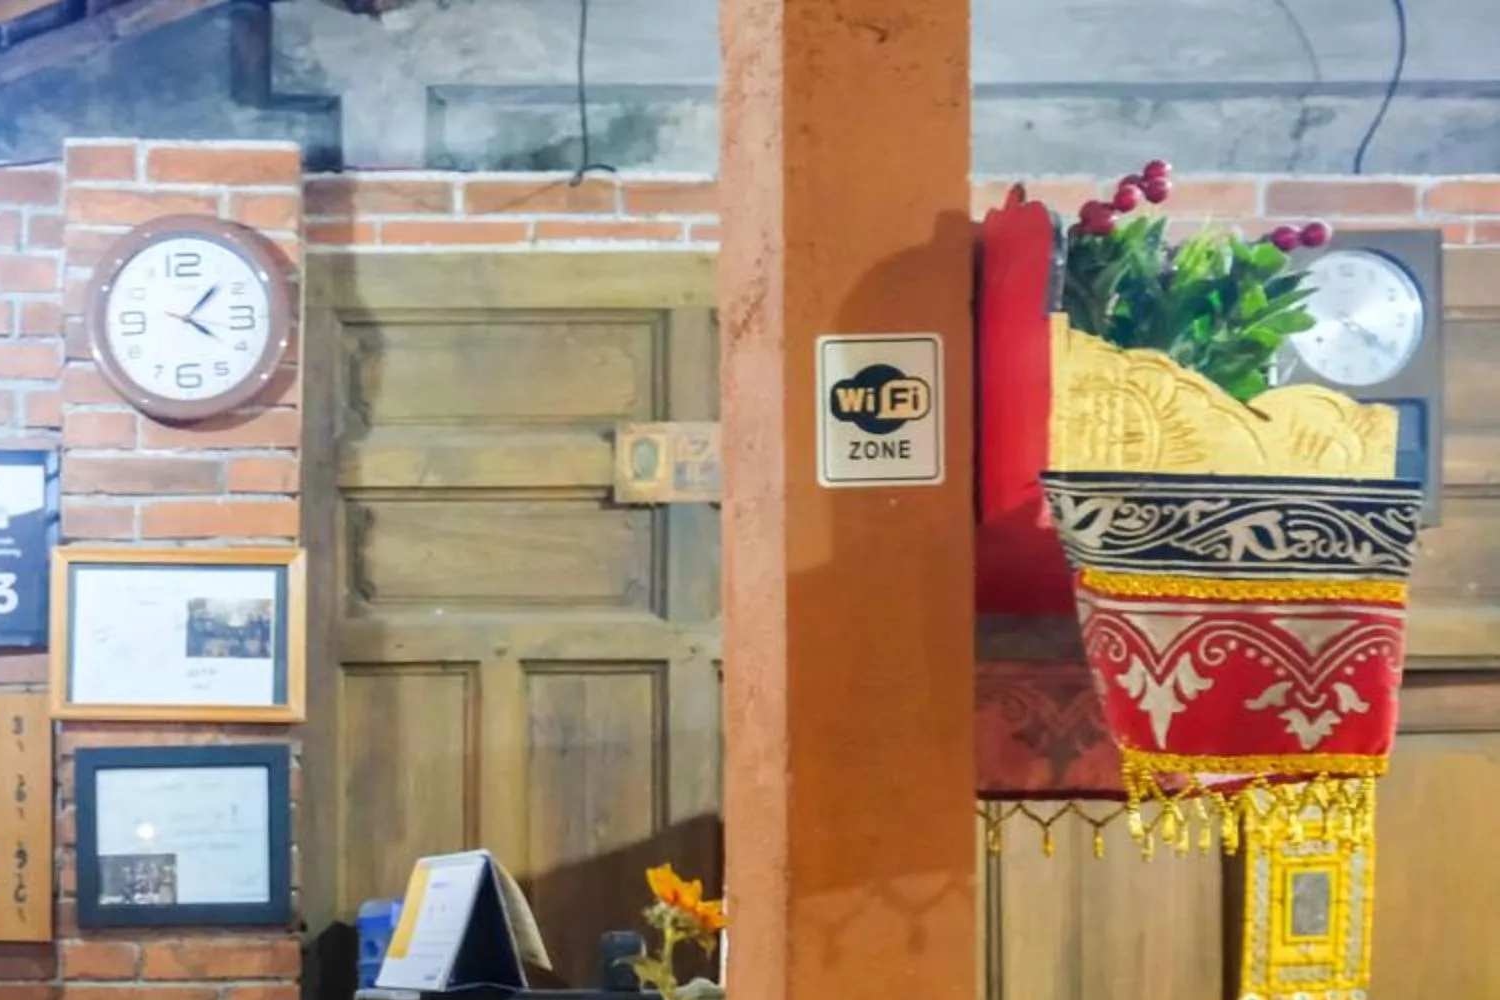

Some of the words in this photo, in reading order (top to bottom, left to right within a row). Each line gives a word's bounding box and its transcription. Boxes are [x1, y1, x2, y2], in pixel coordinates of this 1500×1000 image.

[164, 251, 203, 278] 12
[119, 310, 148, 337] 9
[228, 304, 256, 331] 3
[174, 361, 204, 390] 6
[213, 360, 231, 377] 5
[848, 440, 912, 461] ZONE
